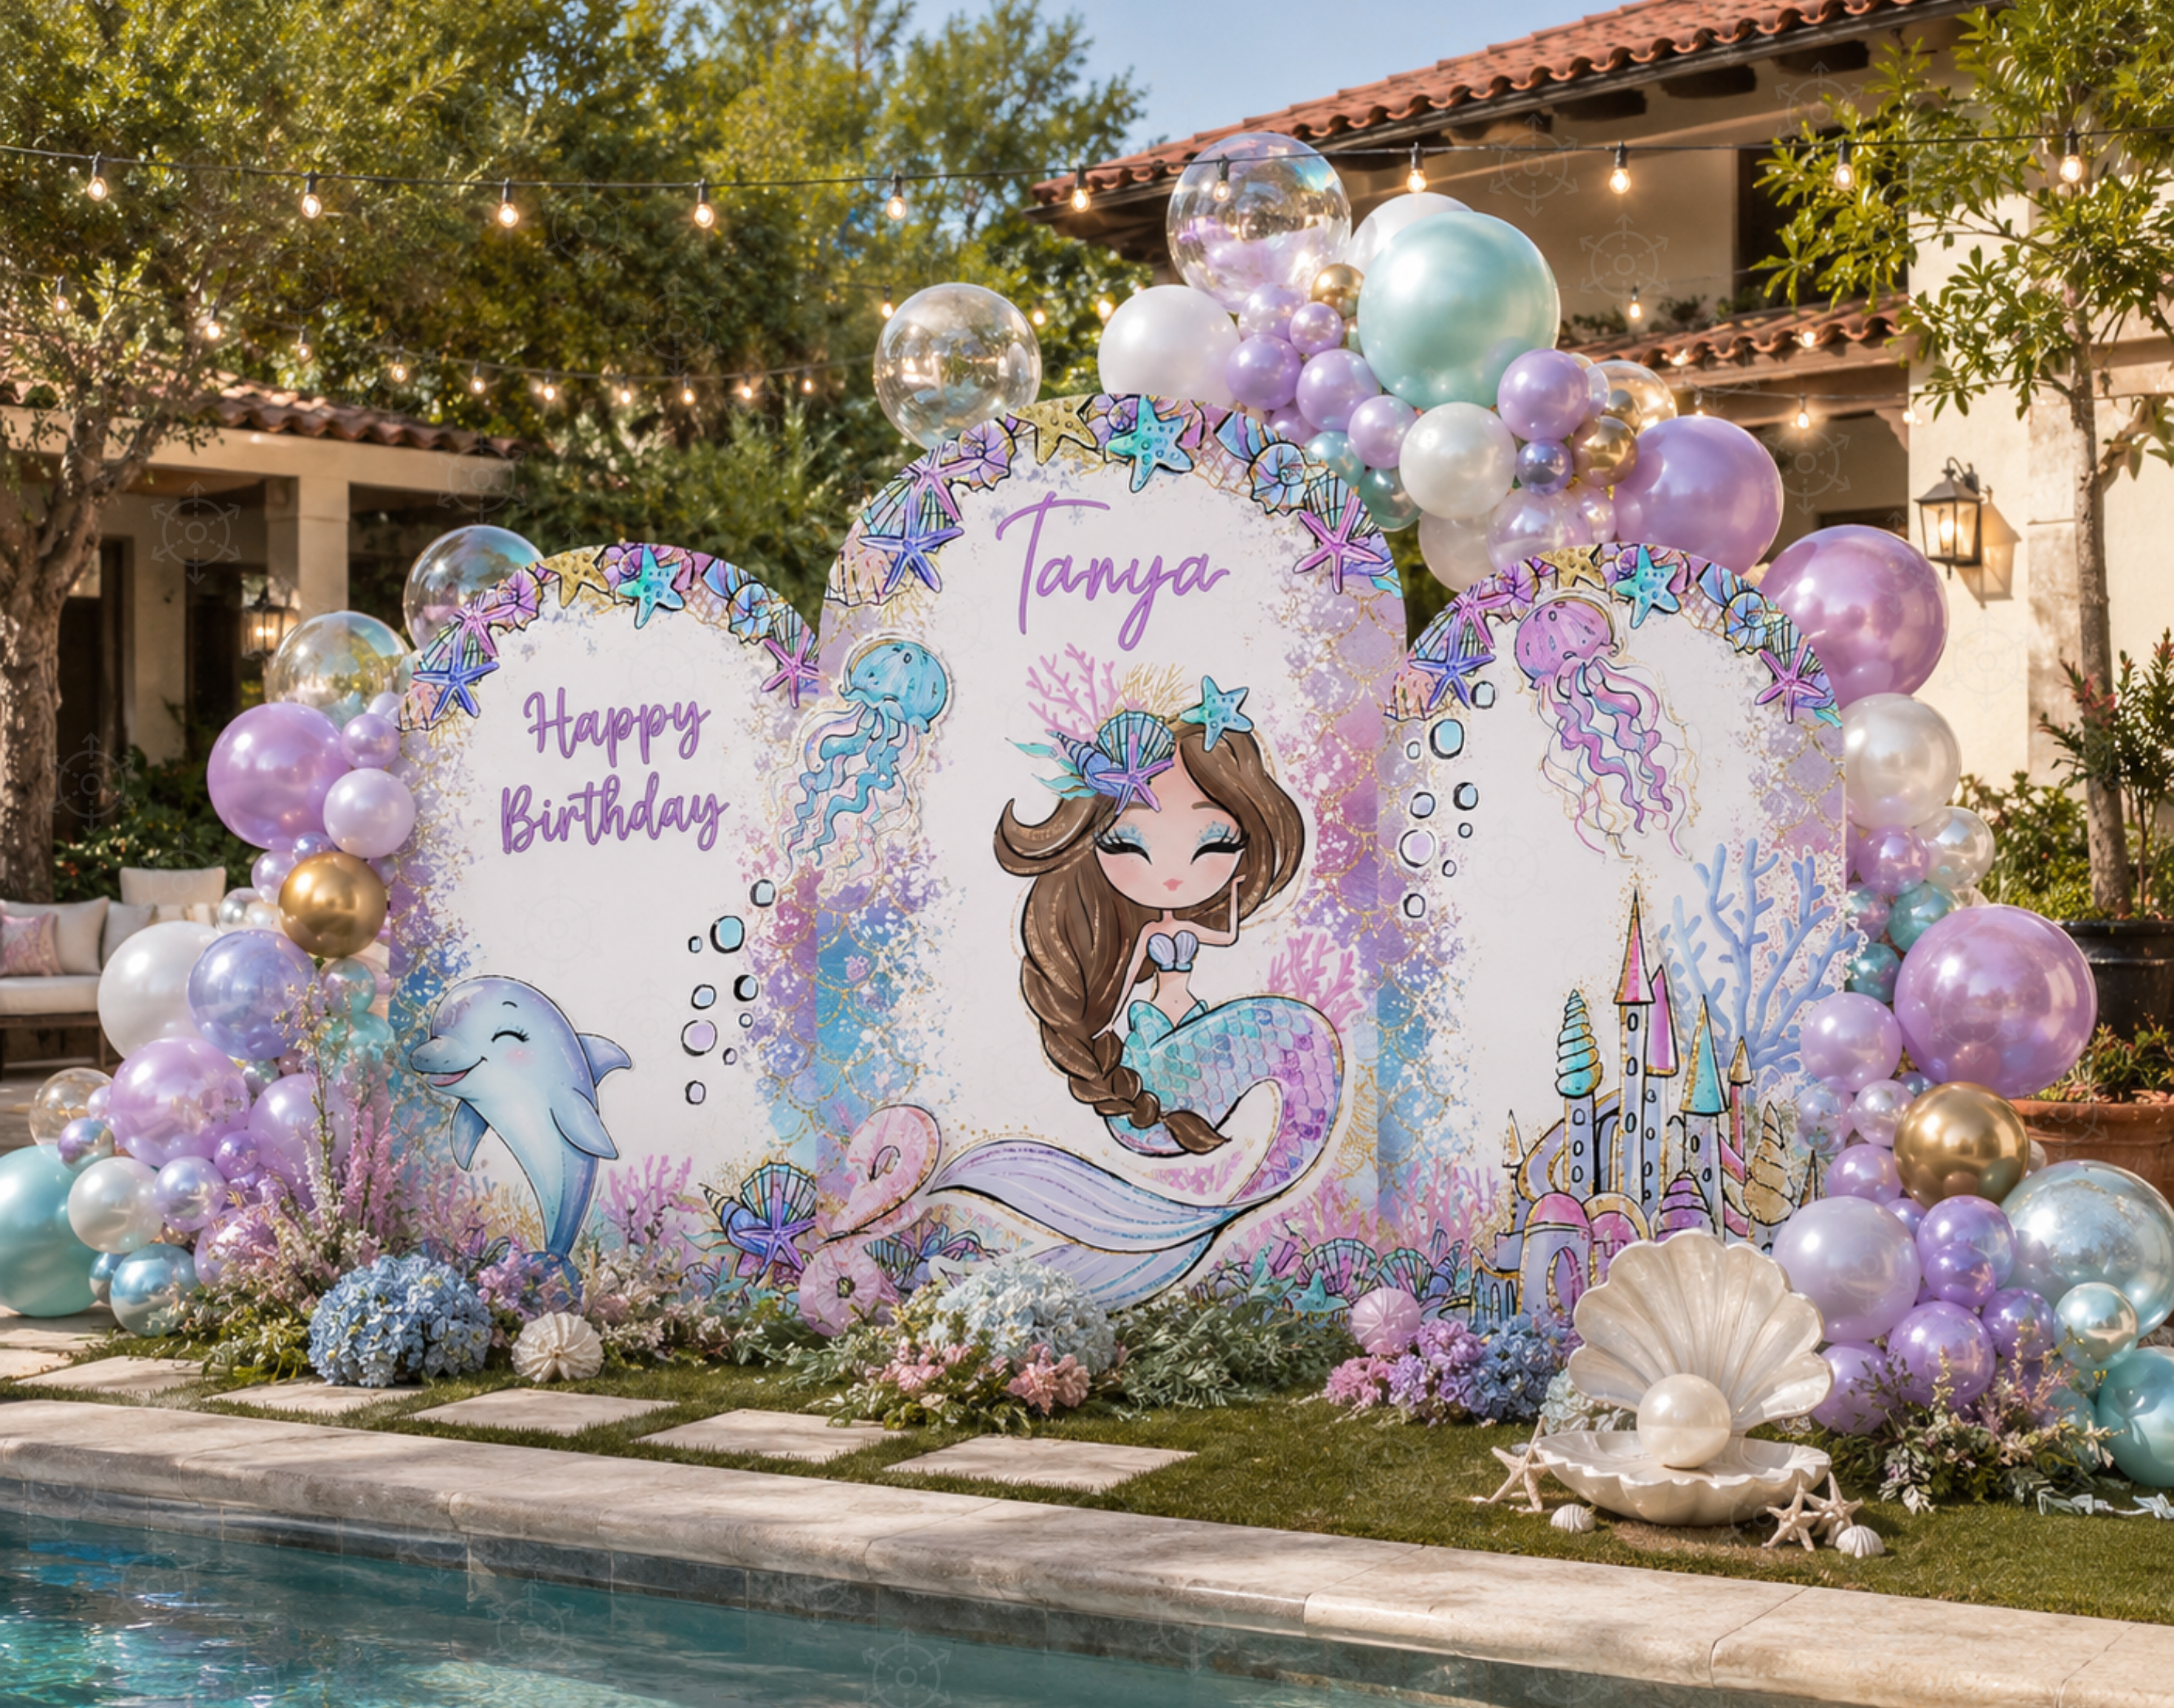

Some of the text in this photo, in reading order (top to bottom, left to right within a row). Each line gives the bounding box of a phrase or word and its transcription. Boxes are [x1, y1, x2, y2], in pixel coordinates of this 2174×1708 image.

[996, 491, 1230, 651] Tanya
[524, 687, 711, 768] Happy
[502, 771, 730, 853] Birthday
